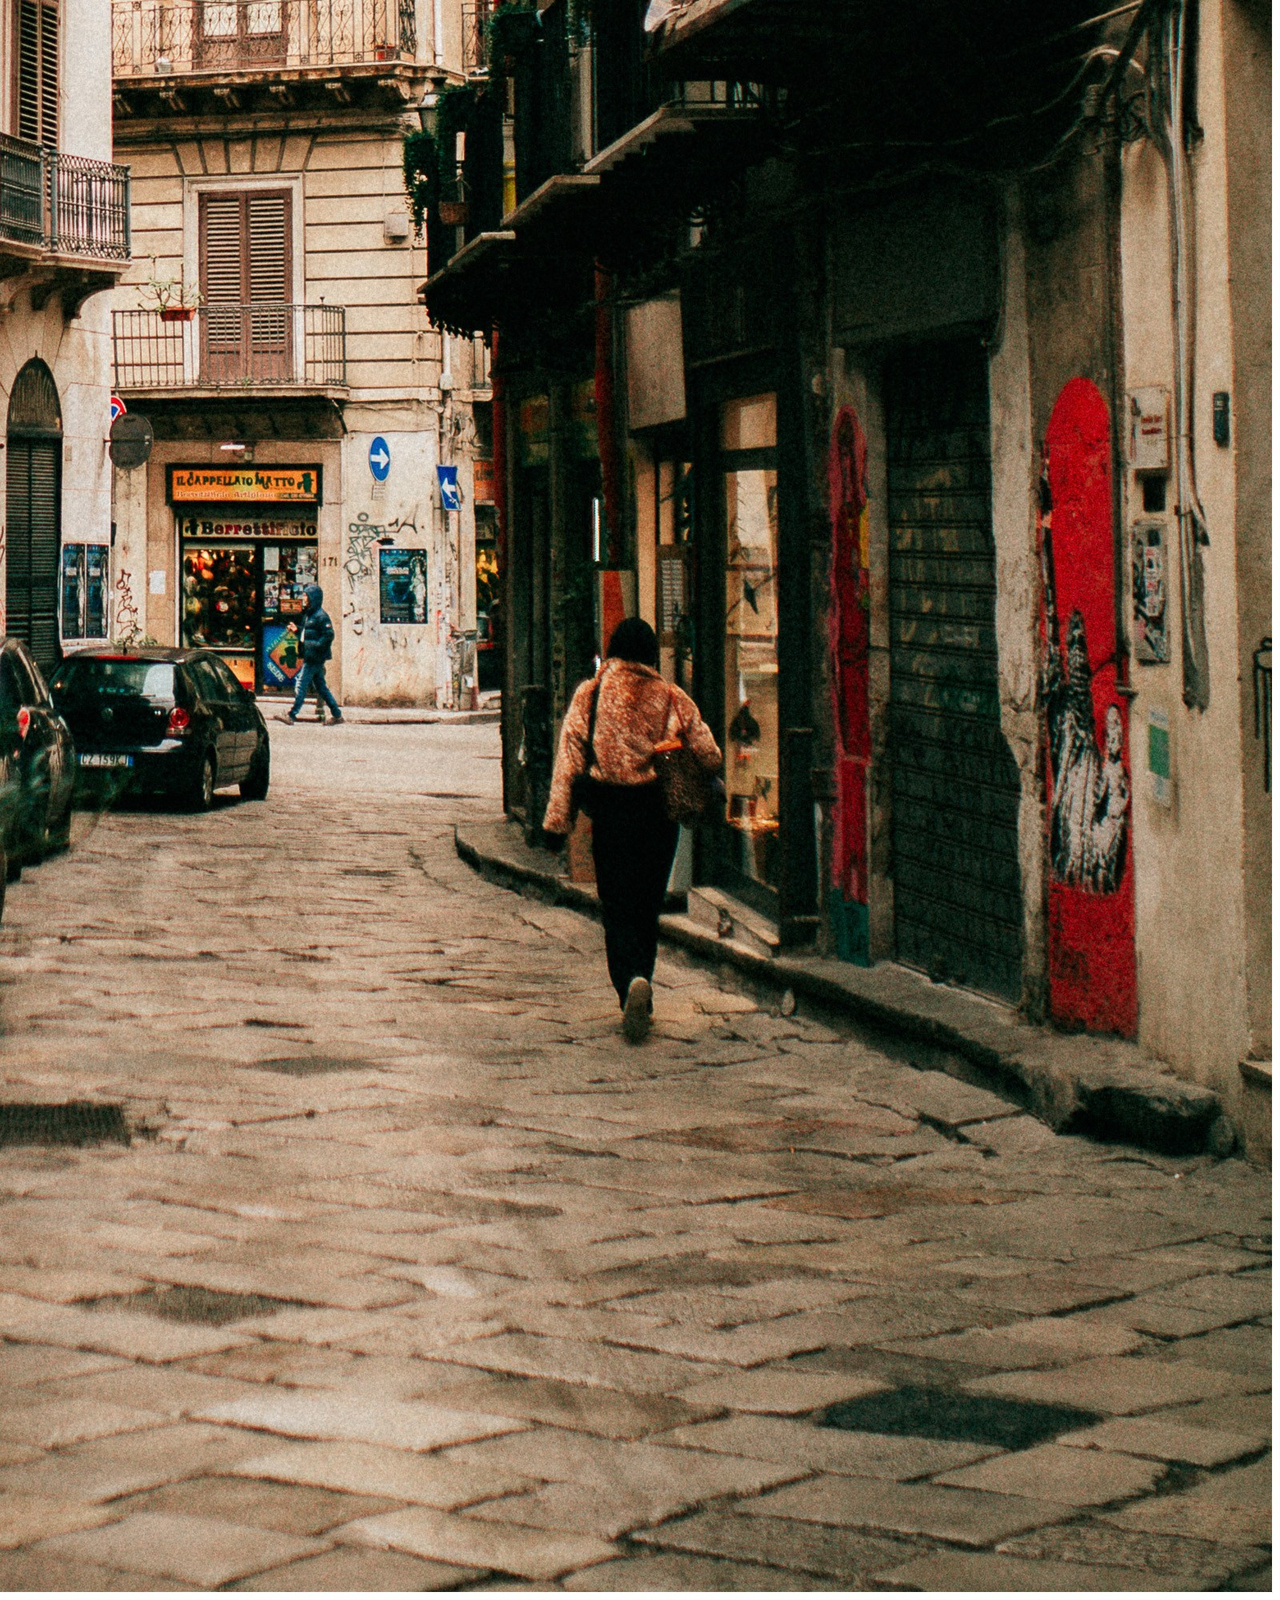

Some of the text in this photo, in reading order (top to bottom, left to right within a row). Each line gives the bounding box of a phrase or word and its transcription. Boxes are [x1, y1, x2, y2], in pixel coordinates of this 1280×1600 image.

[176, 472, 295, 489] IL CAPPELLAIO MATTO
[201, 521, 317, 536] Berrettificio
[322, 556, 338, 567] 171
